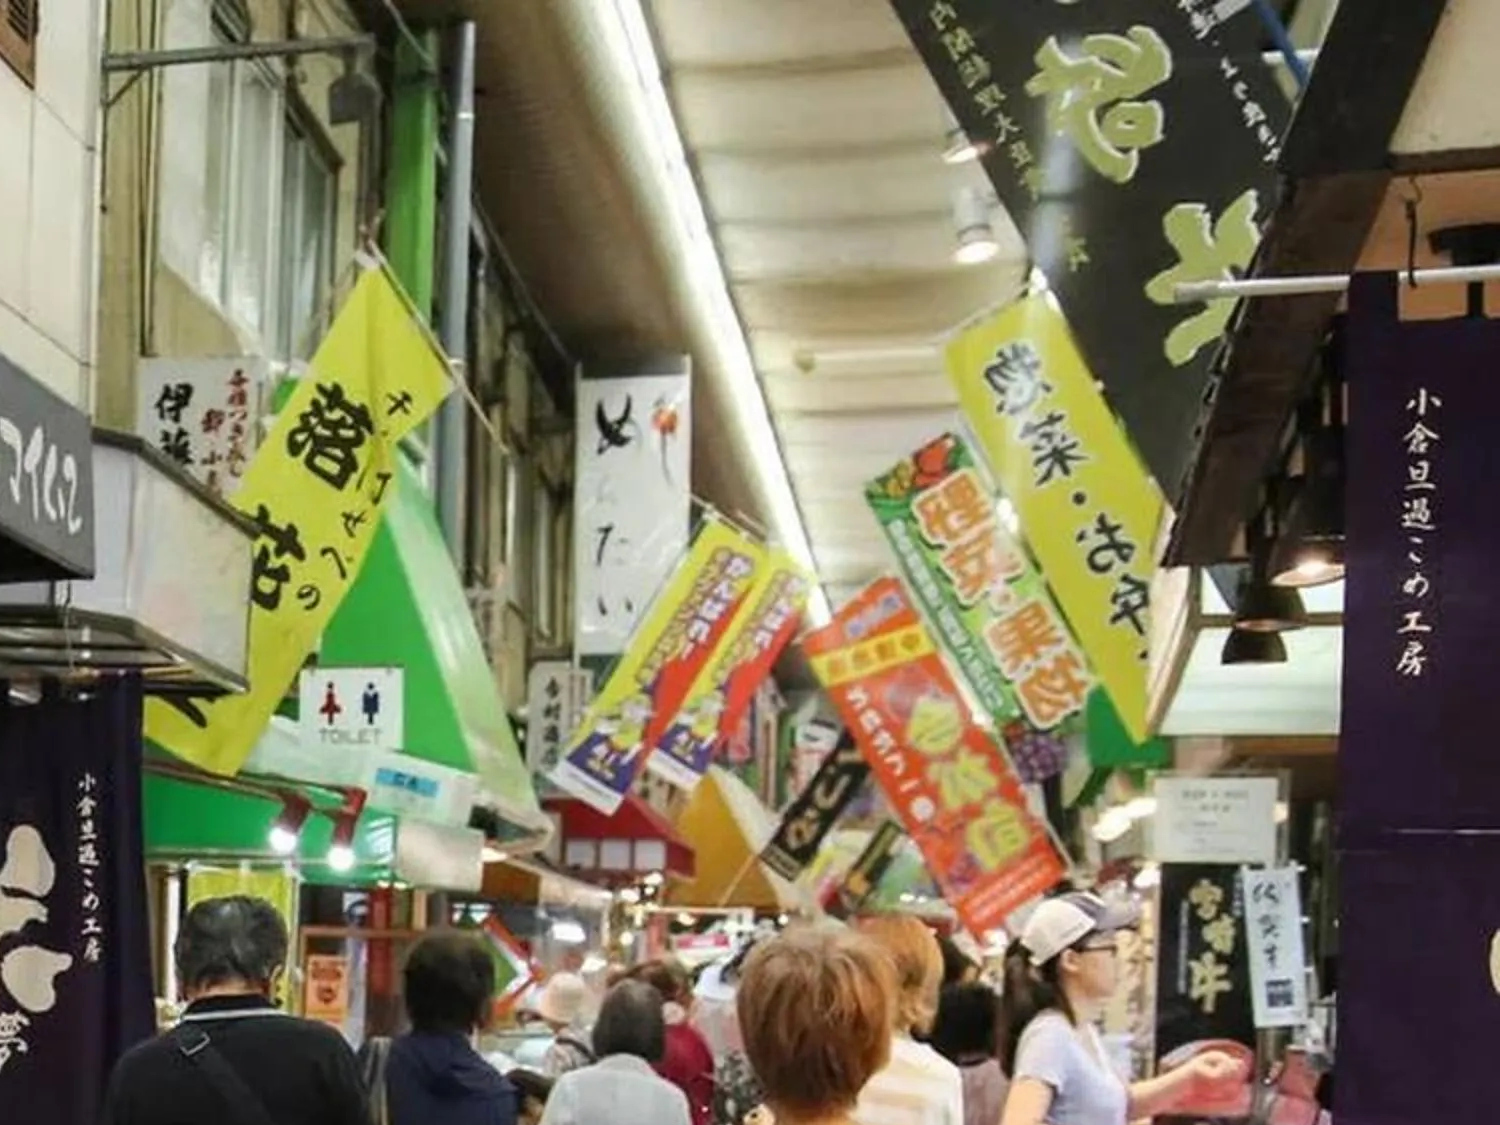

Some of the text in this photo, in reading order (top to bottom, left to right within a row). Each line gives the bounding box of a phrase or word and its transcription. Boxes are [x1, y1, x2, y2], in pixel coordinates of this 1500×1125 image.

[1396, 387, 1443, 676] 小倉旦過こめ工房
[319, 727, 383, 745] TOILET
[76, 772, 104, 963] 小倉旦過こめ工房
